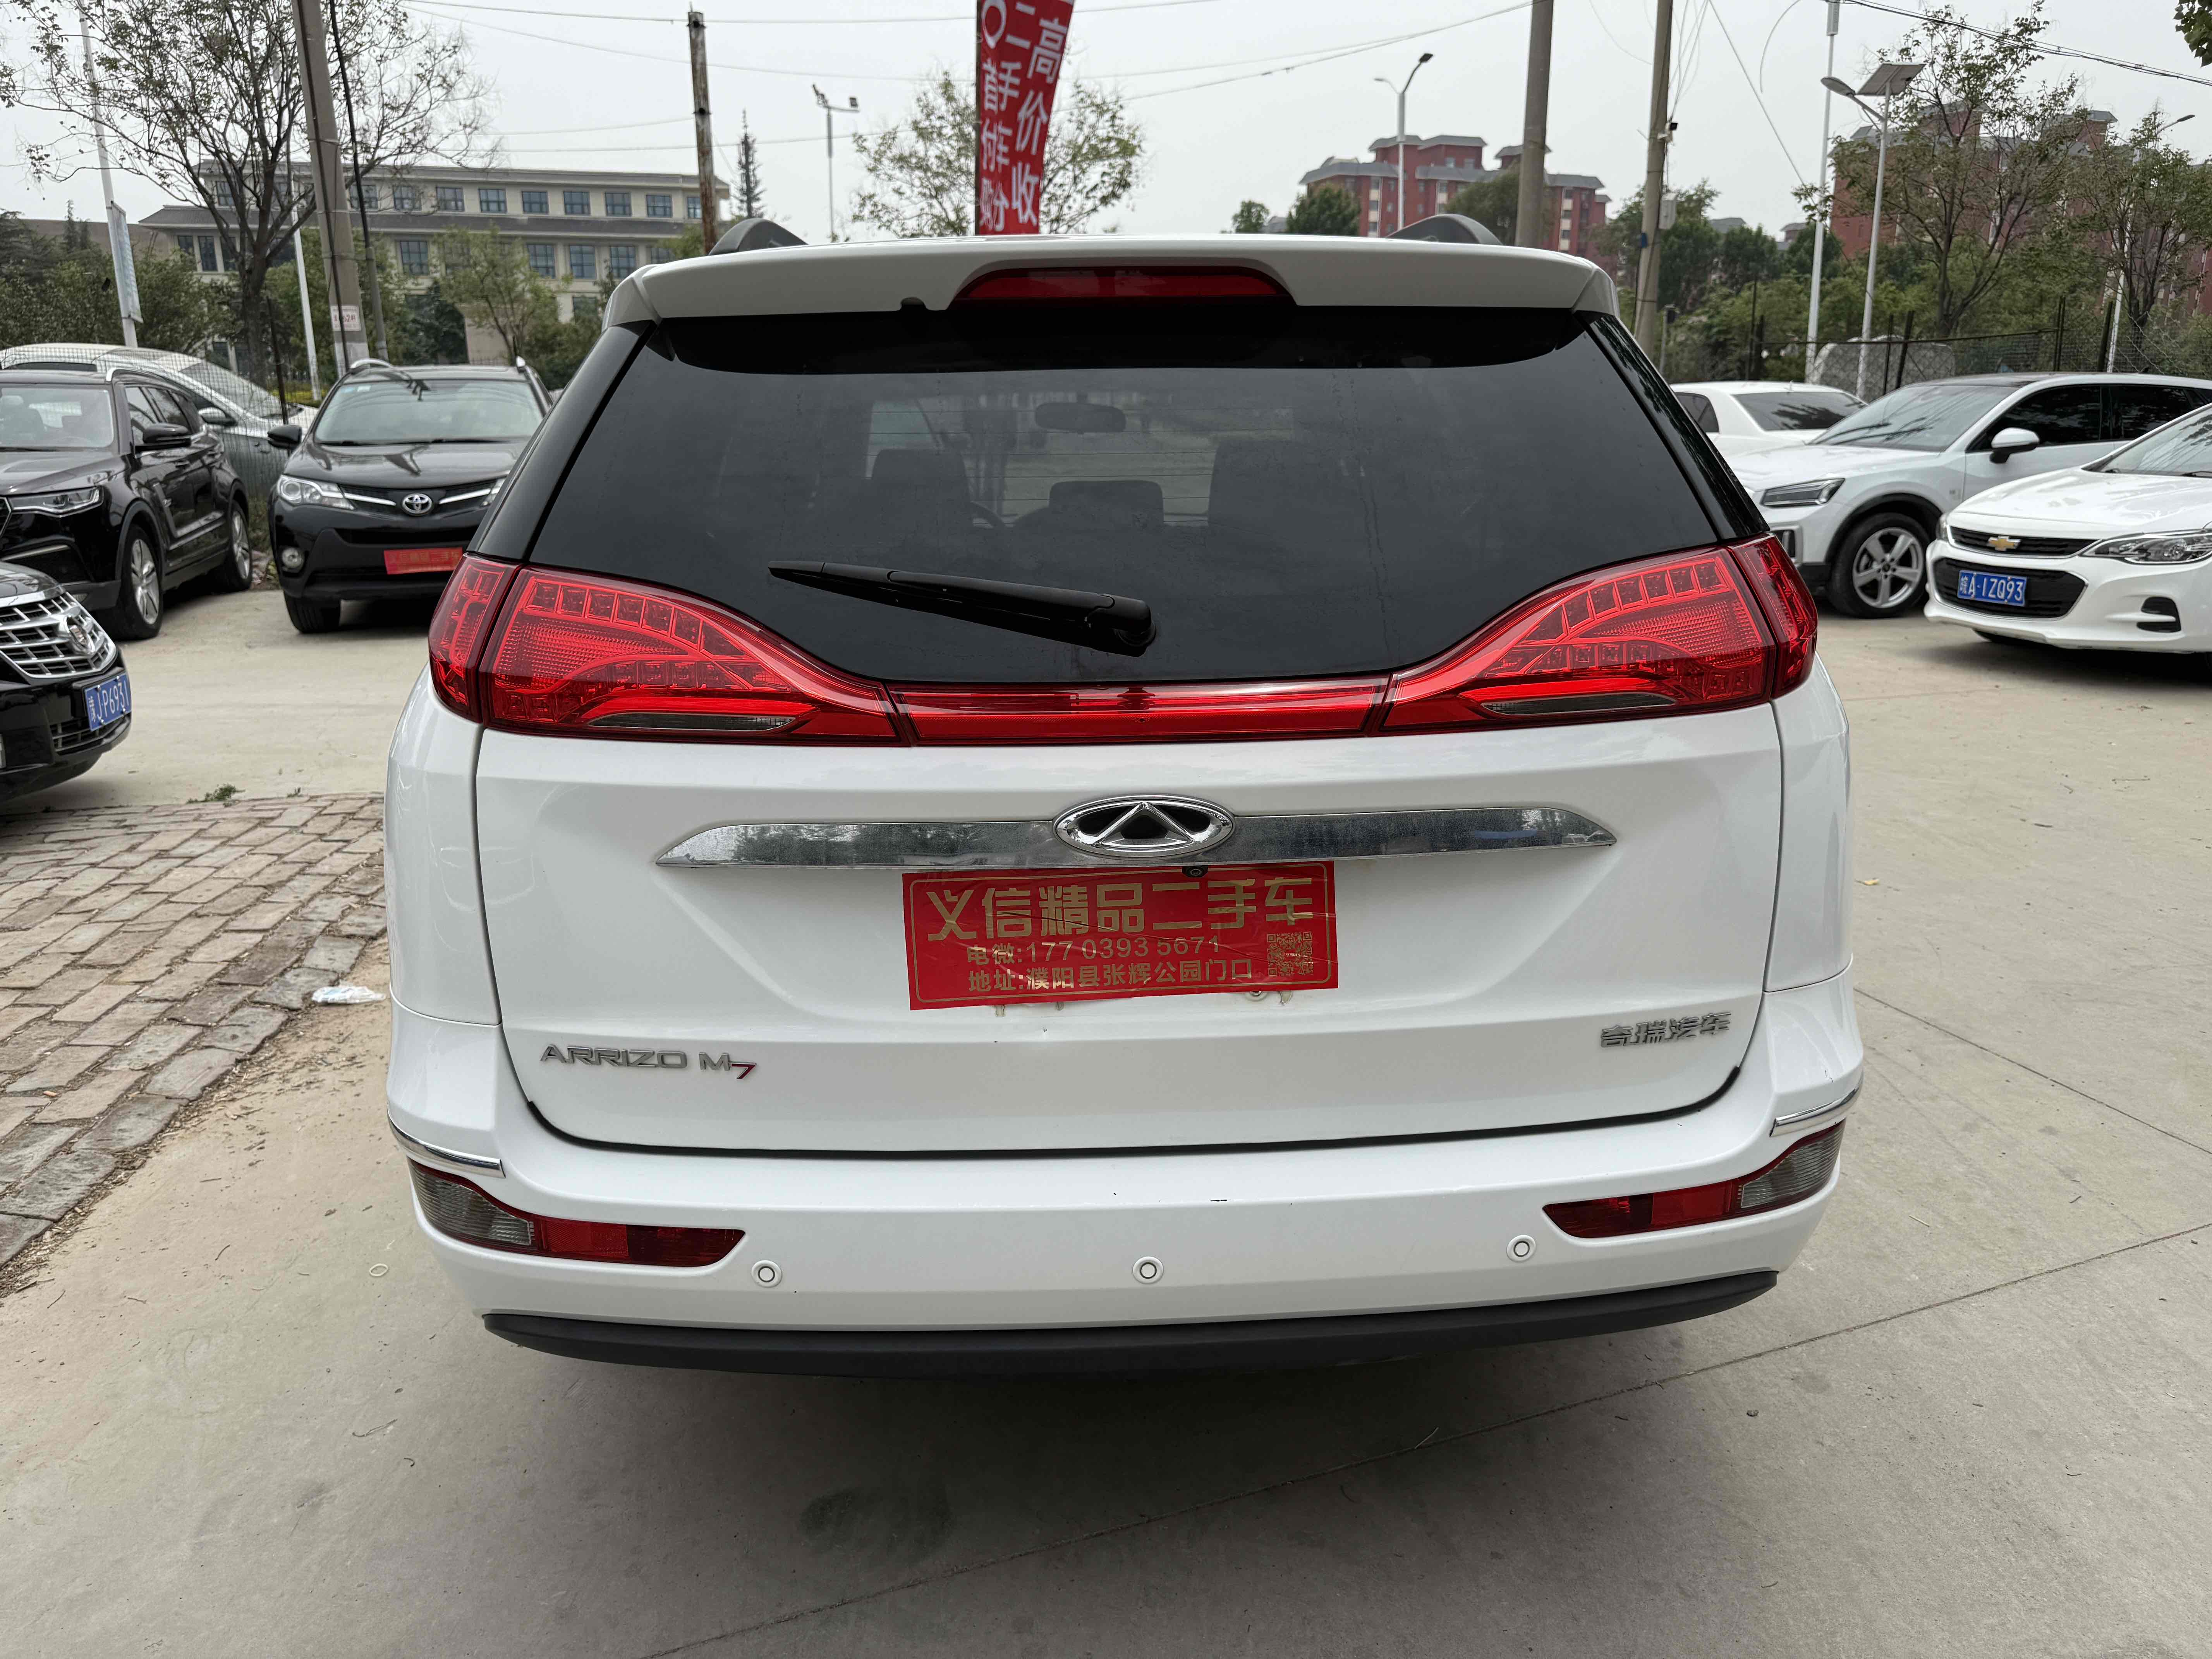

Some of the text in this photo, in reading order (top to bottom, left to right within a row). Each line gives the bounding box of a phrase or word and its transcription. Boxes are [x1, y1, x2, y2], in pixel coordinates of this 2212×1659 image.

[926, 877, 1313, 941] 义信精品二手车
[1082, 937, 1149, 960] 0393
[1156, 935, 1219, 956] 5671
[968, 958, 1252, 992] 地址:濮阳县张辉公园门口
[1601, 1012, 1731, 1048] 奇瑞汽车
[540, 1044, 757, 1079] ARRIZO M7
